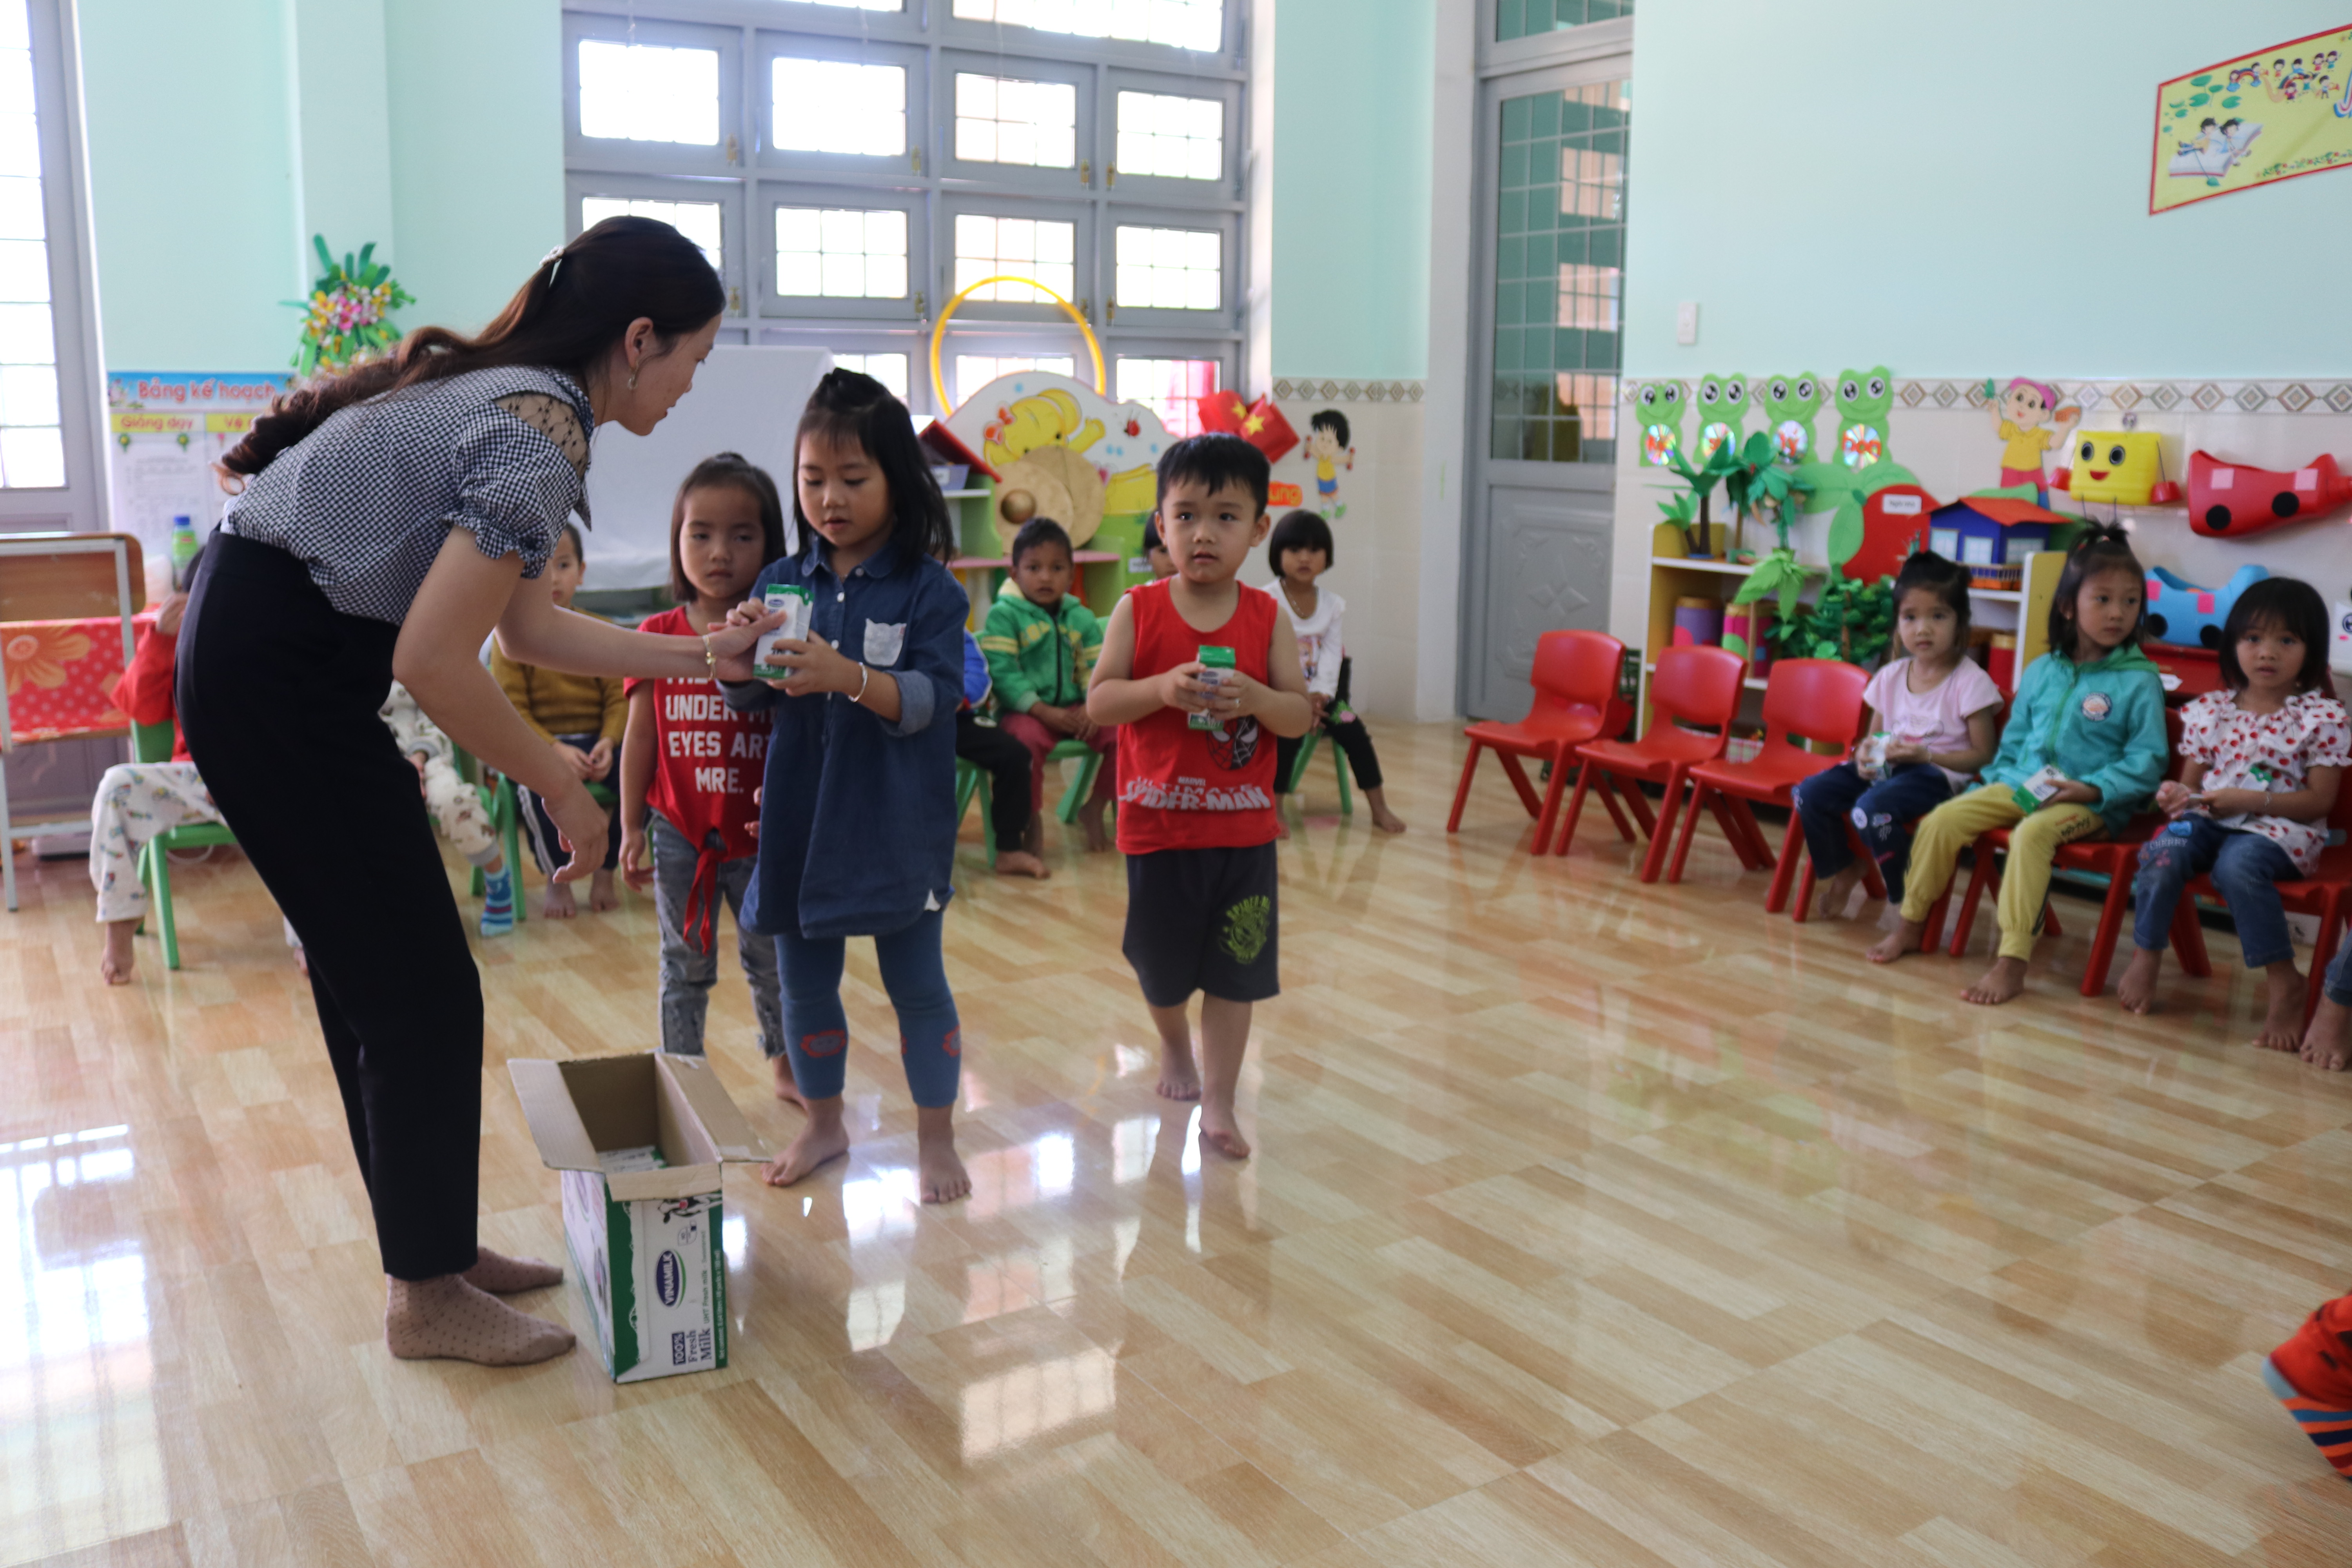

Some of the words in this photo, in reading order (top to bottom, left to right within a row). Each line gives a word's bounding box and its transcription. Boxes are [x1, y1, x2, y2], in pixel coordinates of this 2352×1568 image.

[138, 377, 186, 403] Bảng
[190, 378, 216, 399] kế
[668, 731, 722, 758] EYES
[730, 732, 772, 759] AR
[695, 767, 744, 793] MRE.
[1118, 780, 1271, 811] SPIDER-MAN
[662, 1253, 675, 1305] VINAMILK
[673, 1334, 685, 1364] 100%
[687, 1329, 698, 1363] Fresh
[699, 1328, 711, 1361] Milk
